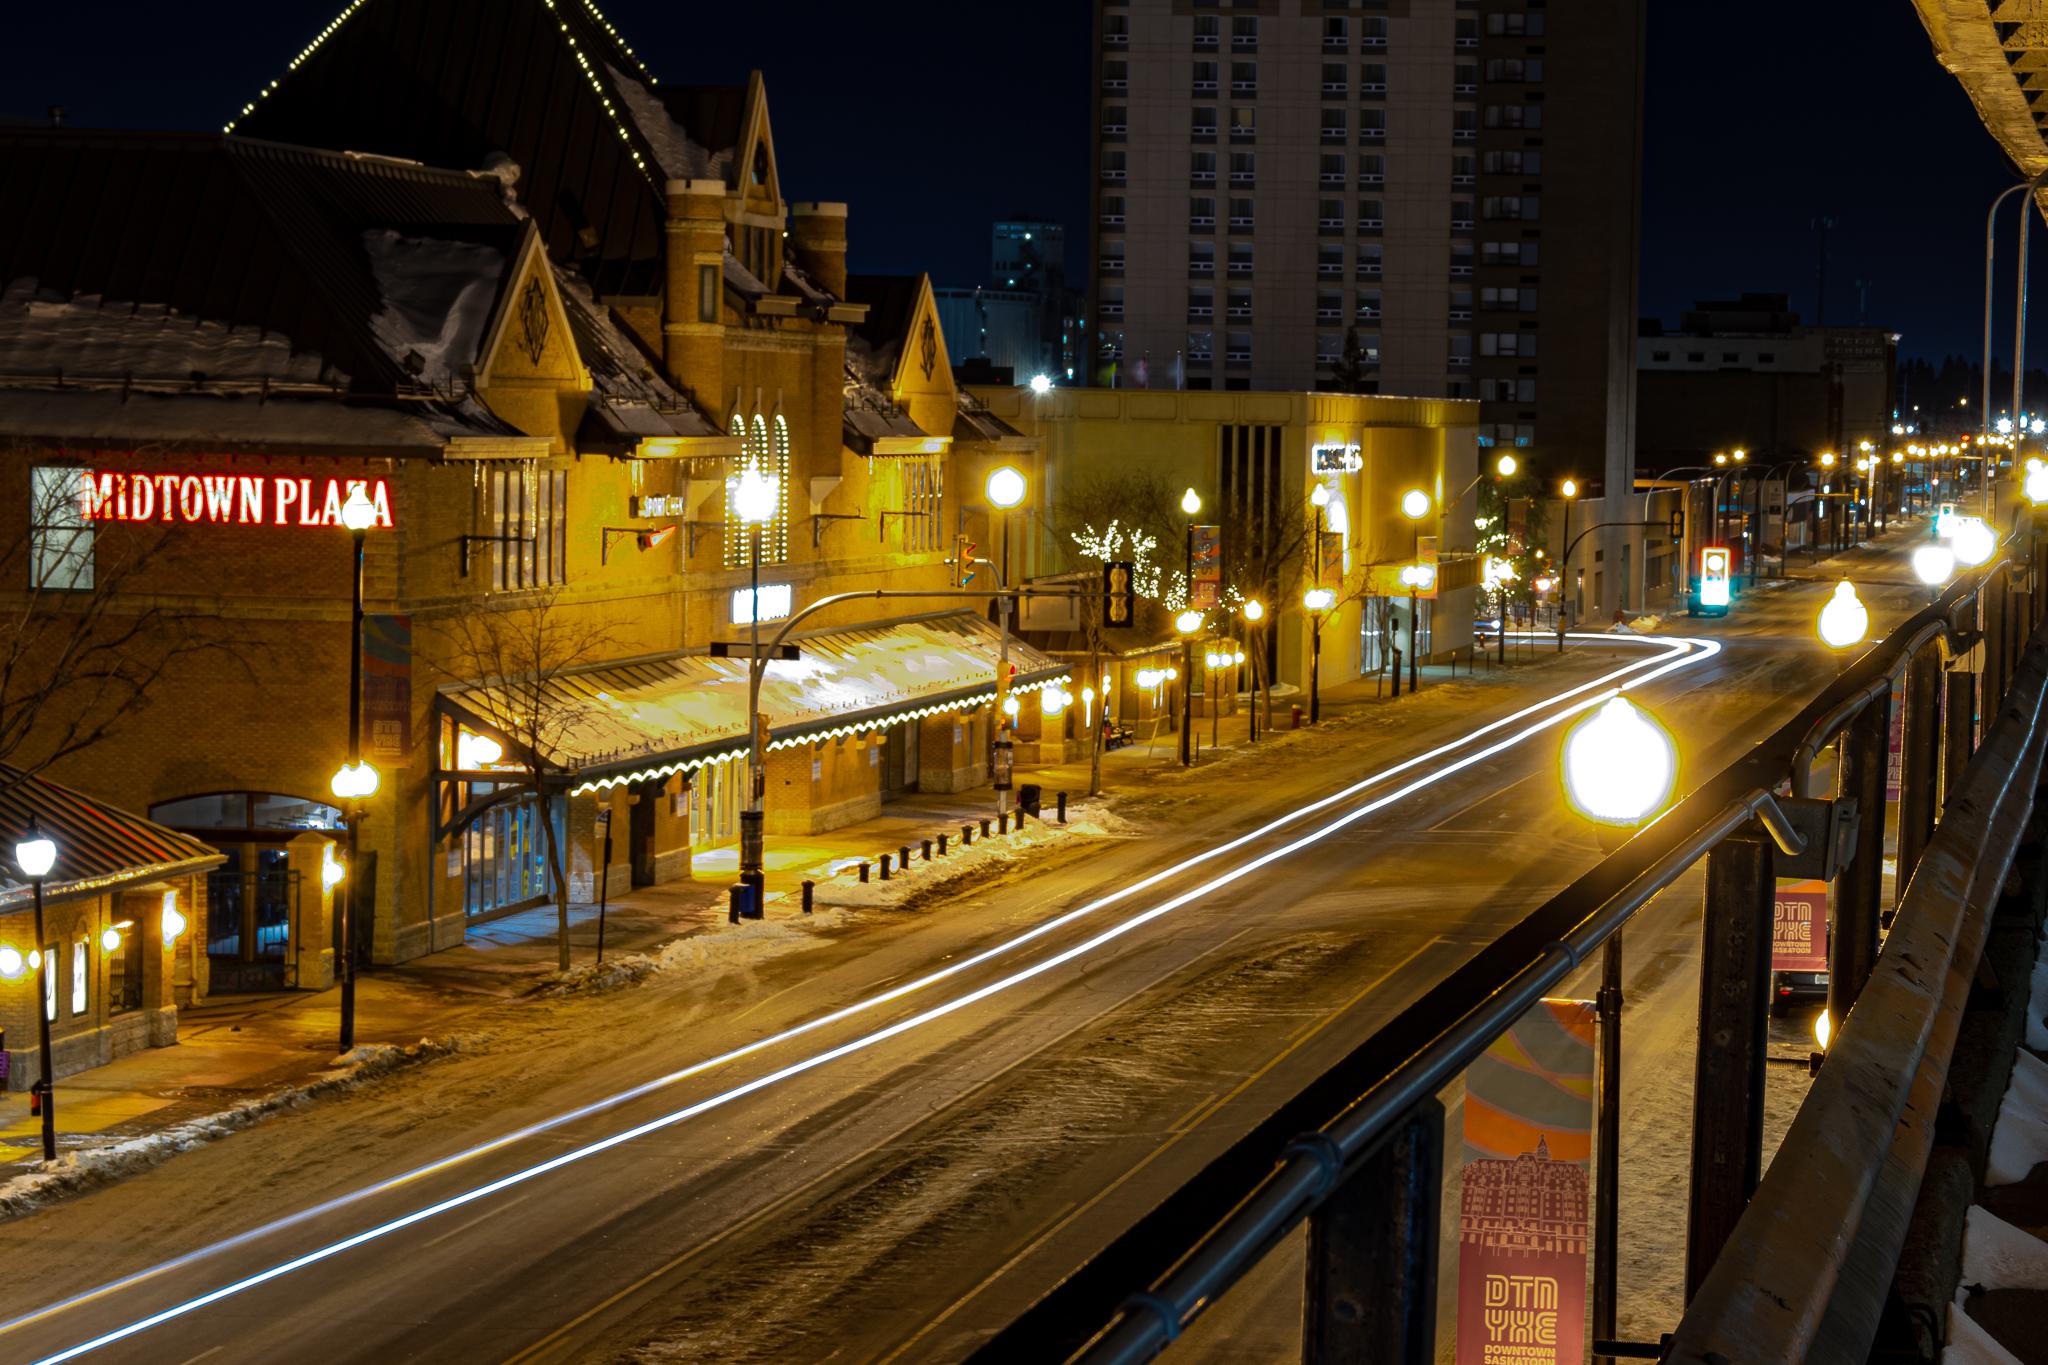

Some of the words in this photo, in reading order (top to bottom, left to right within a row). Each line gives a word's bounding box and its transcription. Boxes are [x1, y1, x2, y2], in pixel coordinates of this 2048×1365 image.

[81, 472, 264, 524] MIDTOWN
[1484, 1273, 1559, 1309] DTN
[1484, 1309, 1558, 1345] YXE
[1484, 1344, 1556, 1358] DOWNTOWN
[1484, 1355, 1556, 1365] SASKATOON
